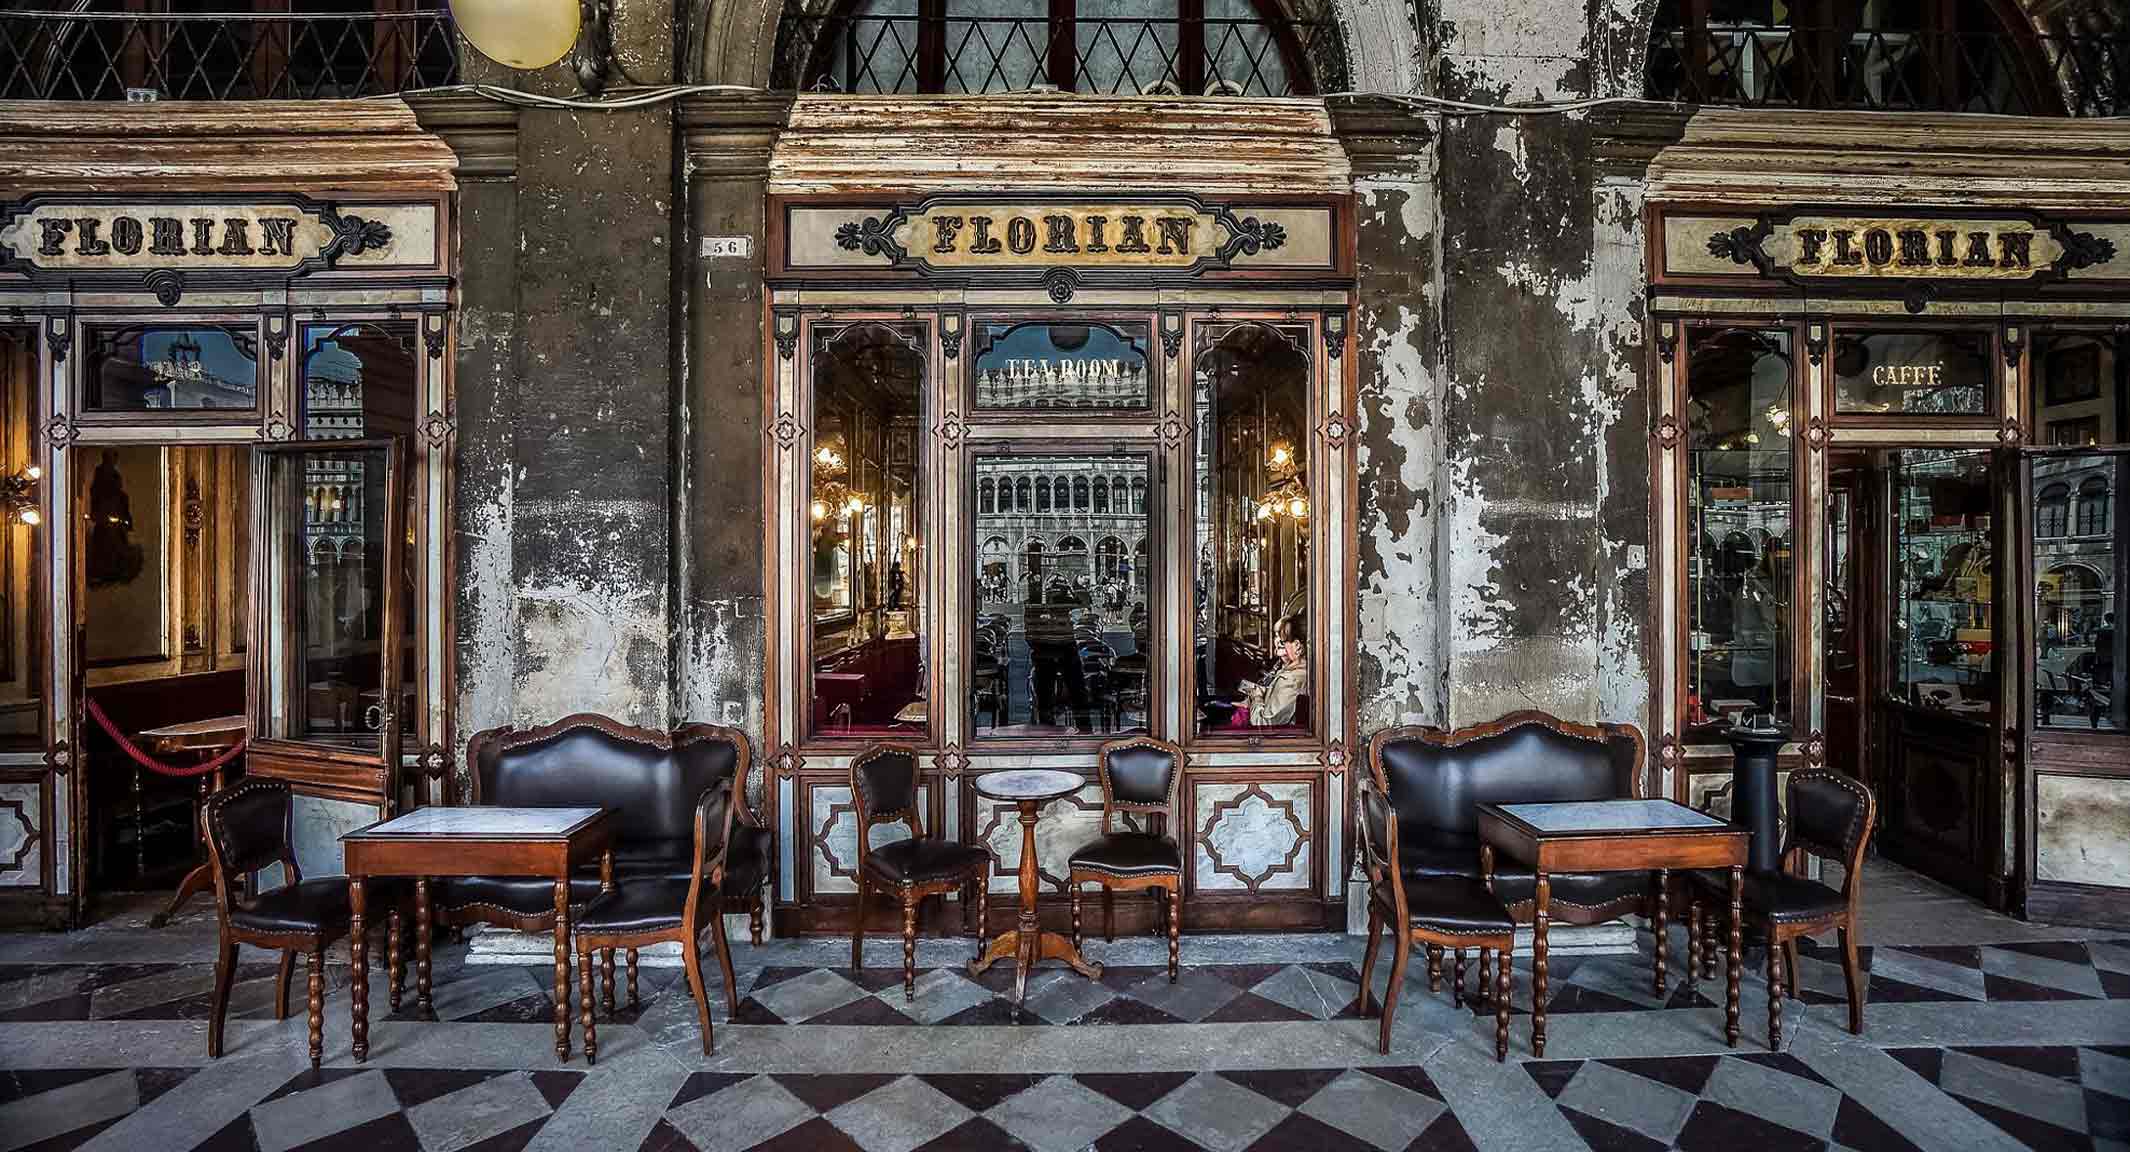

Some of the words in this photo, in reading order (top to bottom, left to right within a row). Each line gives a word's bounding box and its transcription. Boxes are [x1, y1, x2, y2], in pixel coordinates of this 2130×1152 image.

[37, 216, 298, 256] FLORIAN
[932, 215, 1193, 255] FLORIAN
[1798, 228, 2034, 269] FLORIAN
[1006, 359, 1055, 379] TEA
[1060, 359, 1119, 379] ROOM
